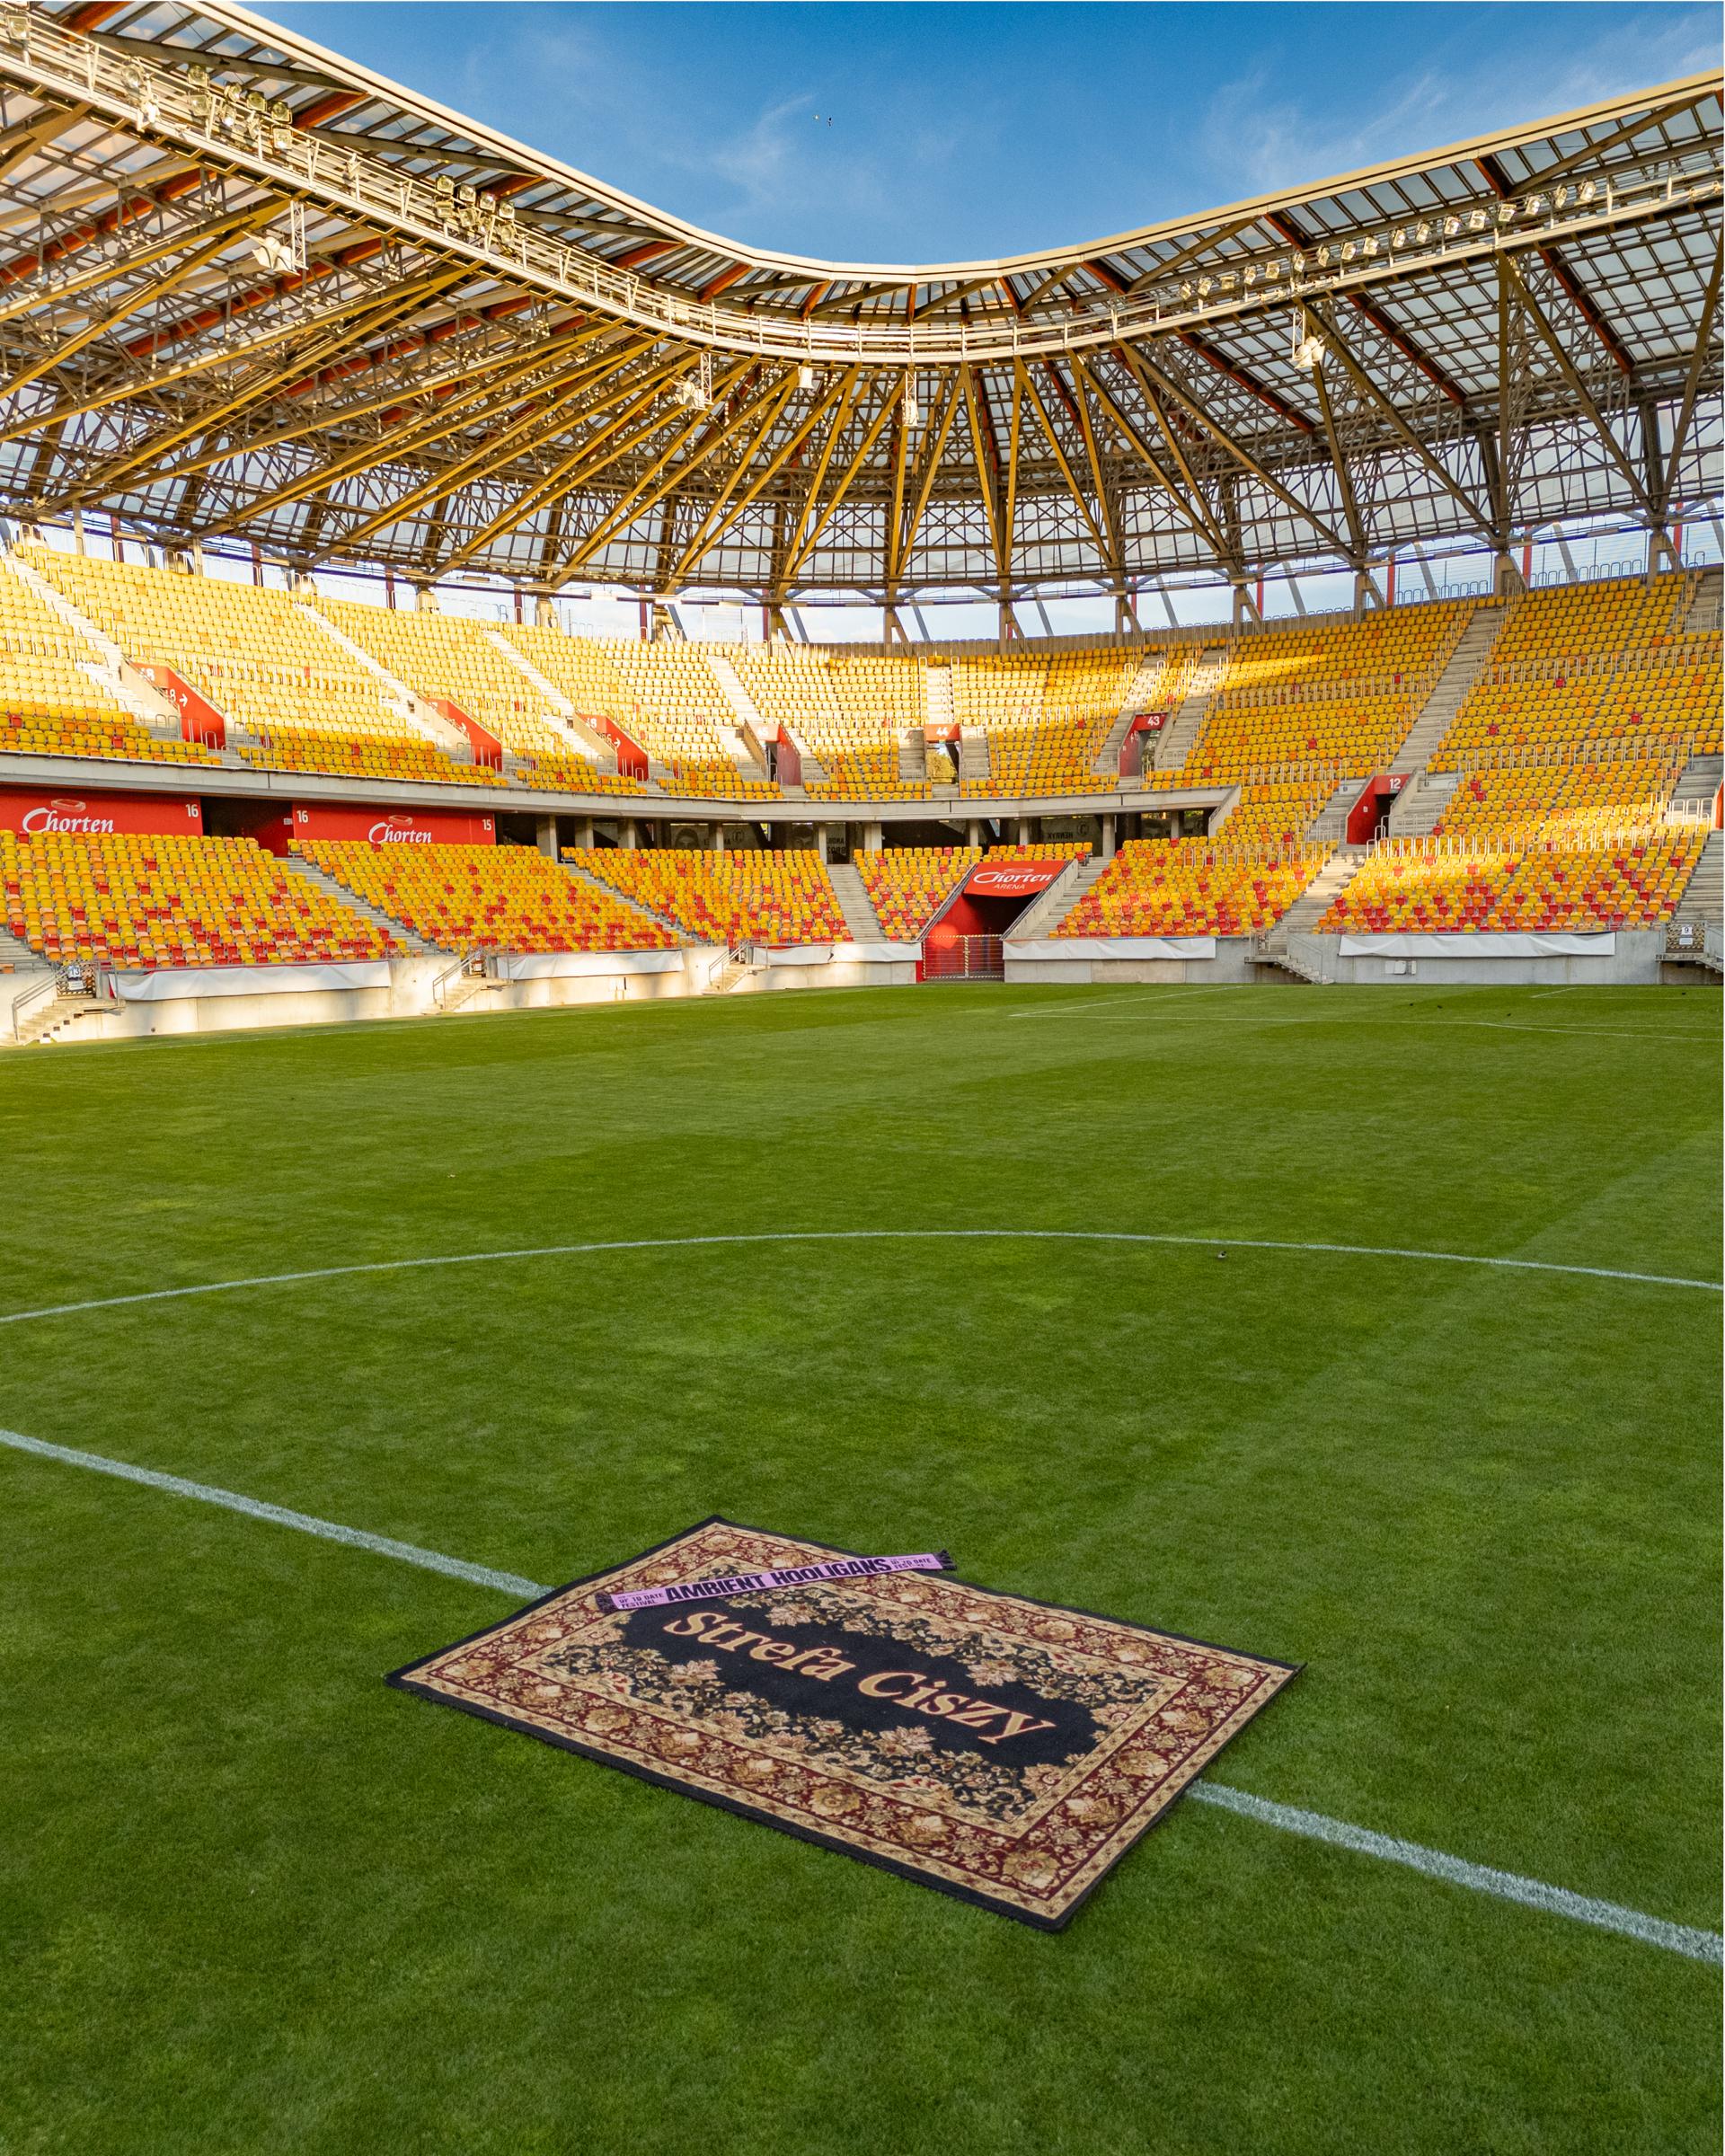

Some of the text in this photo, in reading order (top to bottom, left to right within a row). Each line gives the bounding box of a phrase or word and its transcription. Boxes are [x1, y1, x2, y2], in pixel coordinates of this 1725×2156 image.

[1147, 715, 1160, 726] 43
[936, 727, 949, 737] 44
[1389, 778, 1401, 790] 12
[186, 804, 199, 817] 16
[296, 809, 309, 823] 16
[22, 807, 114, 833] Chorten
[482, 818, 492, 831] 15
[368, 821, 432, 844] Chorten
[973, 871, 1053, 883] Chorten
[665, 1558, 892, 1602] AMBIENT HOOLIGANS
[621, 1599, 656, 1609] FESTIVAL
[663, 1612, 1057, 1745] Strefa Ciszy
